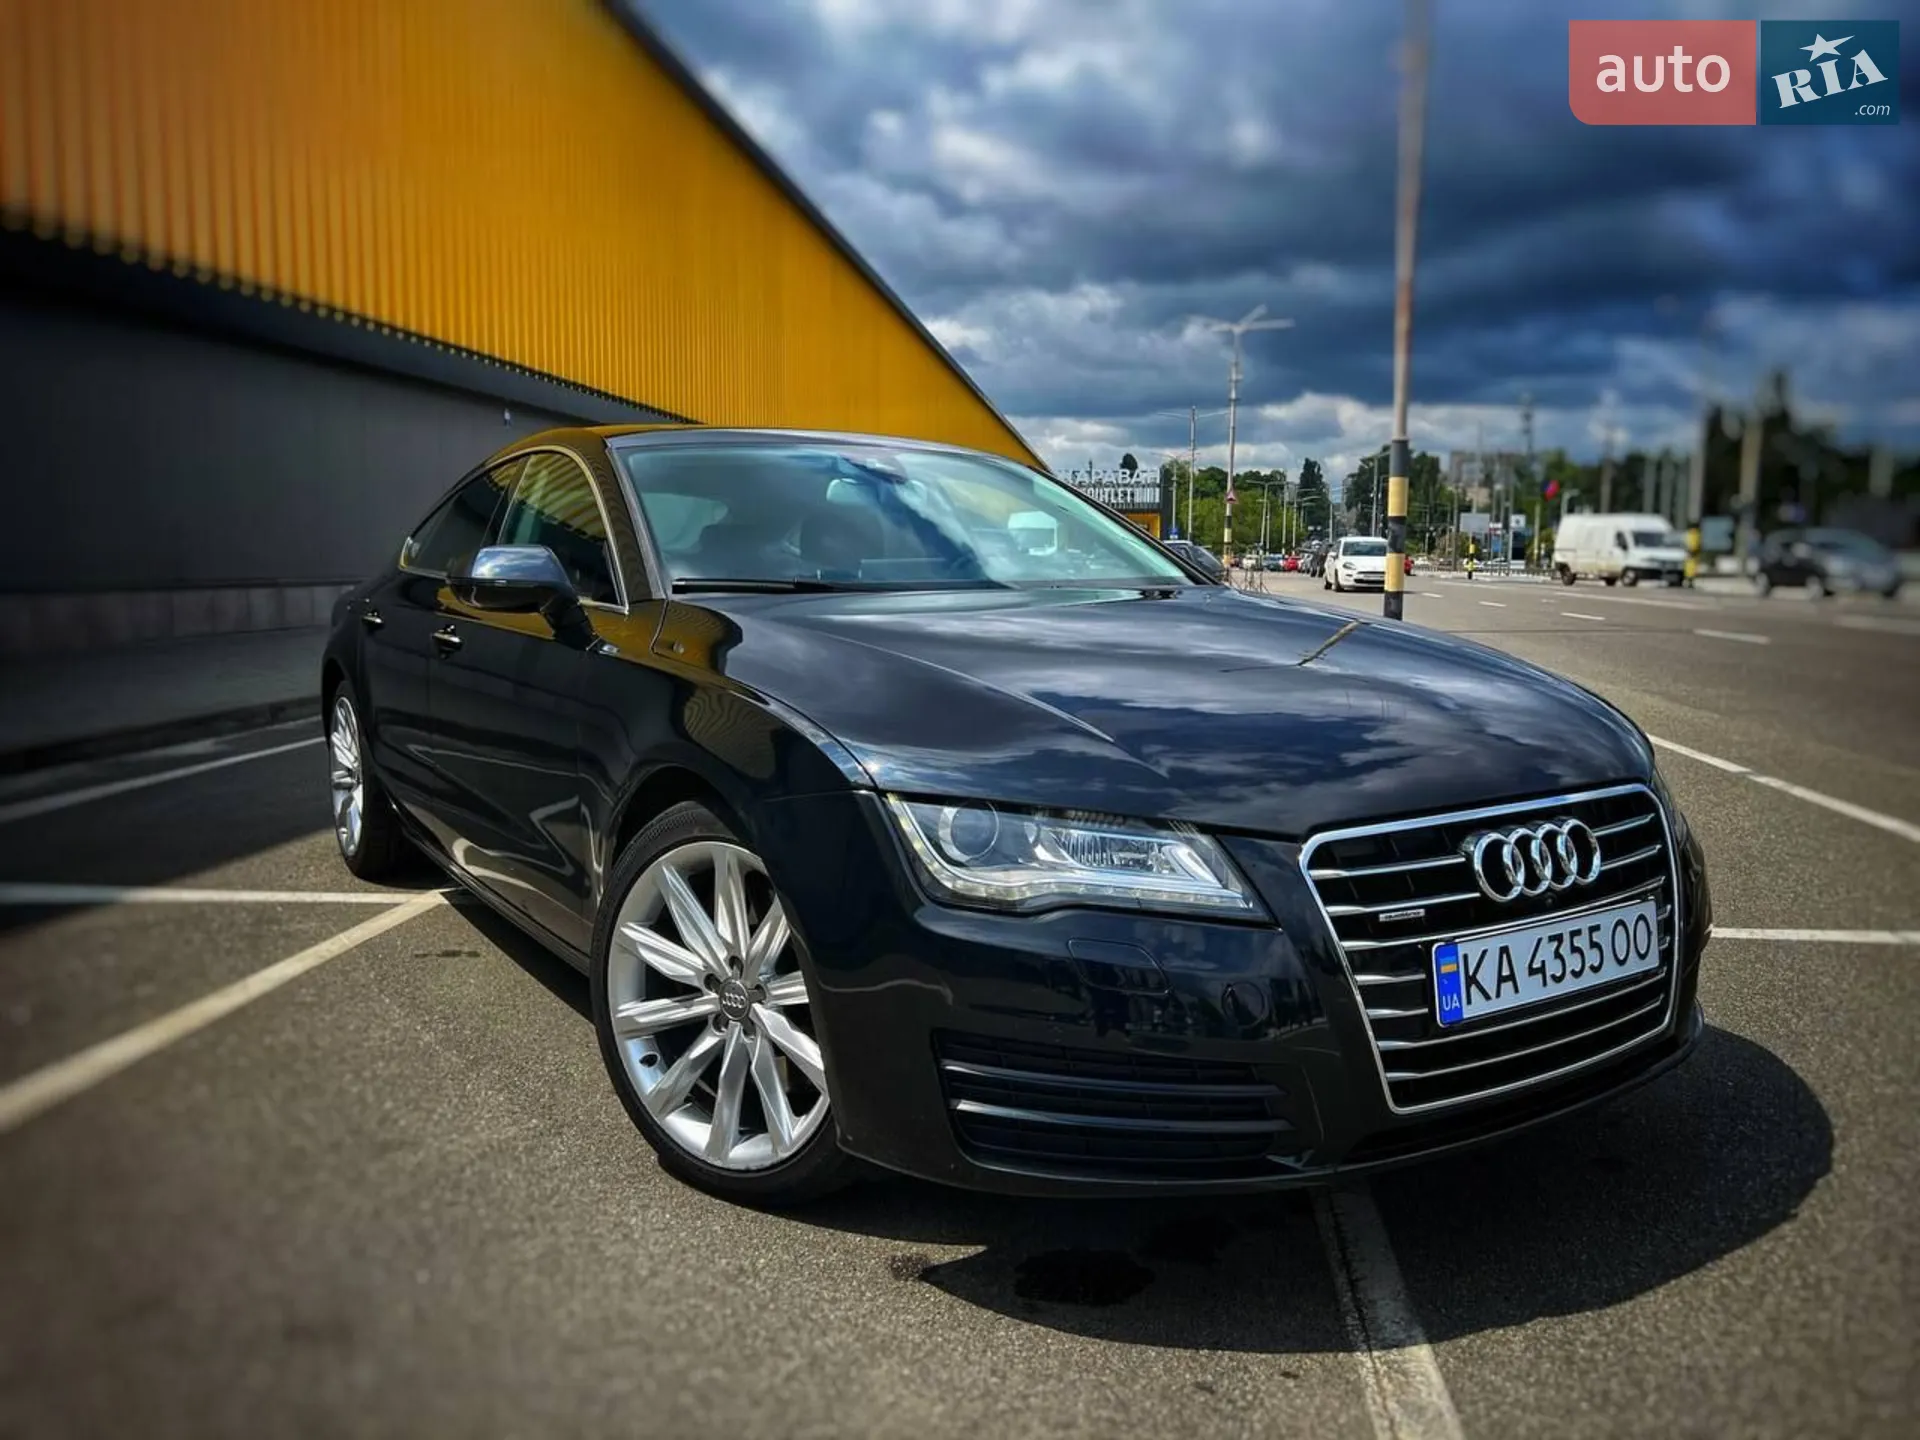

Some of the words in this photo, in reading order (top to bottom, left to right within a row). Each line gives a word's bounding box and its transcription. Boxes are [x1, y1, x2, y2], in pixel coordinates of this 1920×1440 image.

[1462, 945, 1520, 1005] KA
[1527, 924, 1604, 988] 4355
[1442, 995, 1460, 1011] UA
